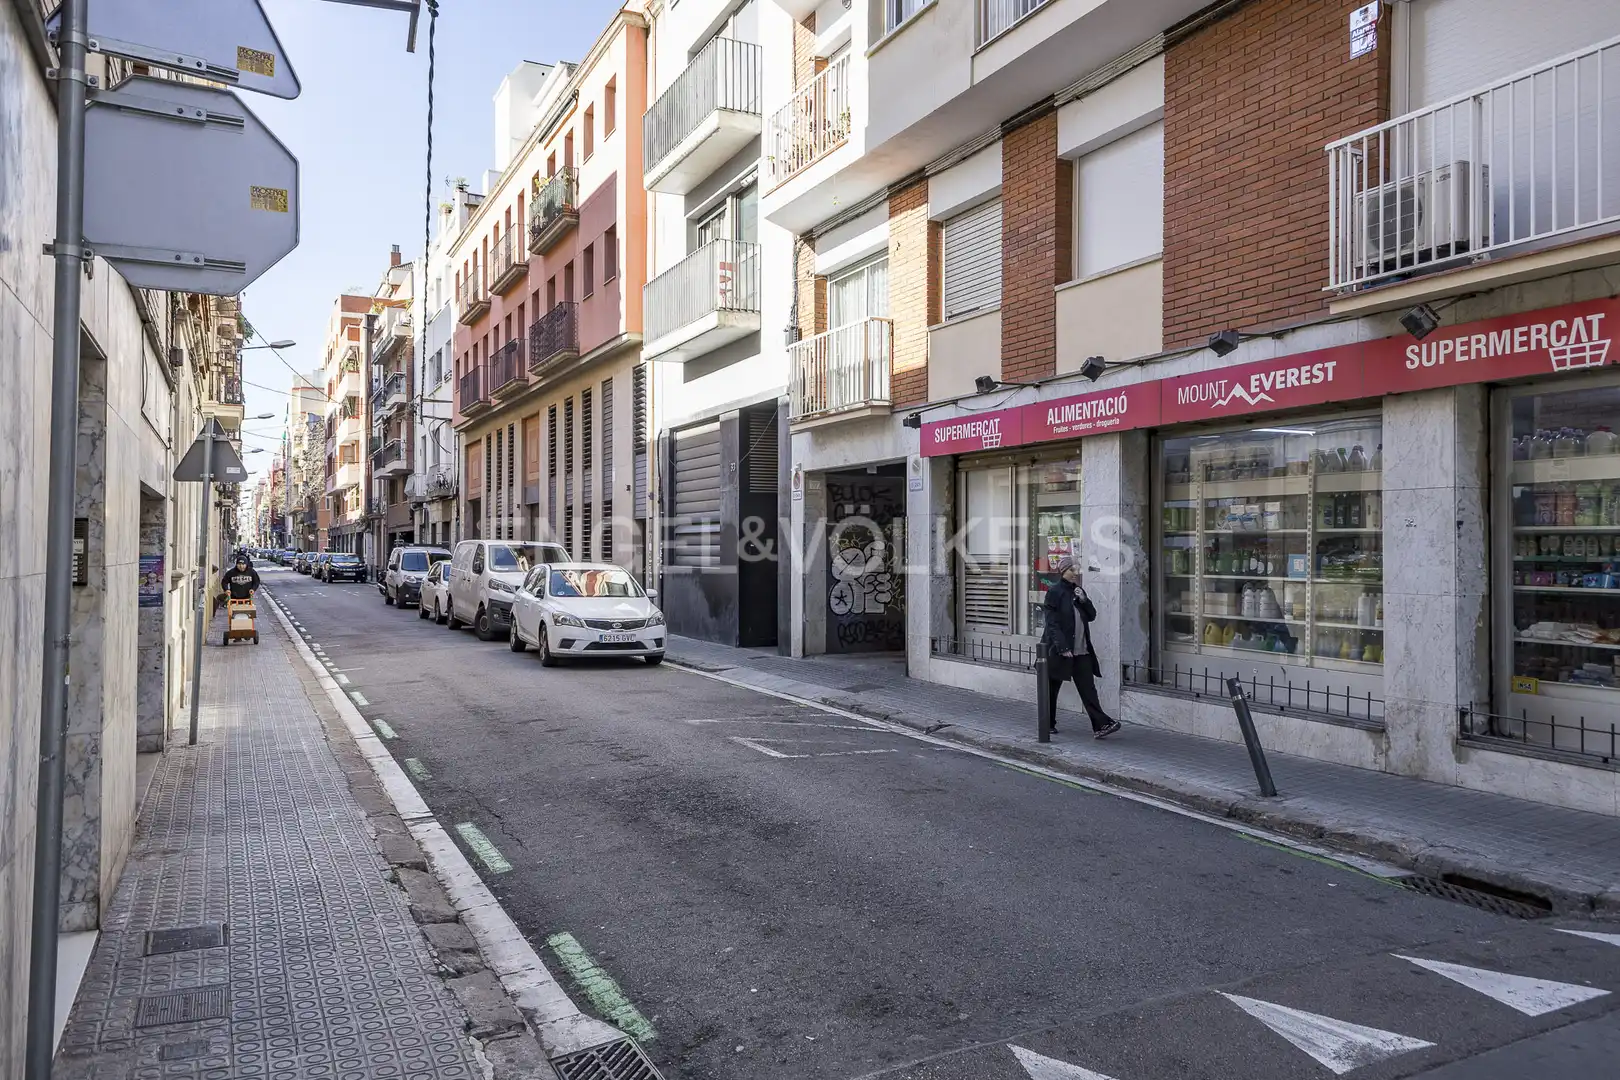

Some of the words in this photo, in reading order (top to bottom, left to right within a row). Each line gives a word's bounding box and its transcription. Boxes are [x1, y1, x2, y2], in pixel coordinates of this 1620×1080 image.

[1405, 313, 1605, 370] SUPERMERCAT
[1178, 380, 1228, 405] MOUNT
[1250, 361, 1337, 393] EVEREST
[1047, 391, 1128, 425] ALIMENTACIÓ
[934, 418, 1000, 443] SUPERMERCAT
[603, 634, 620, 642] 6215
